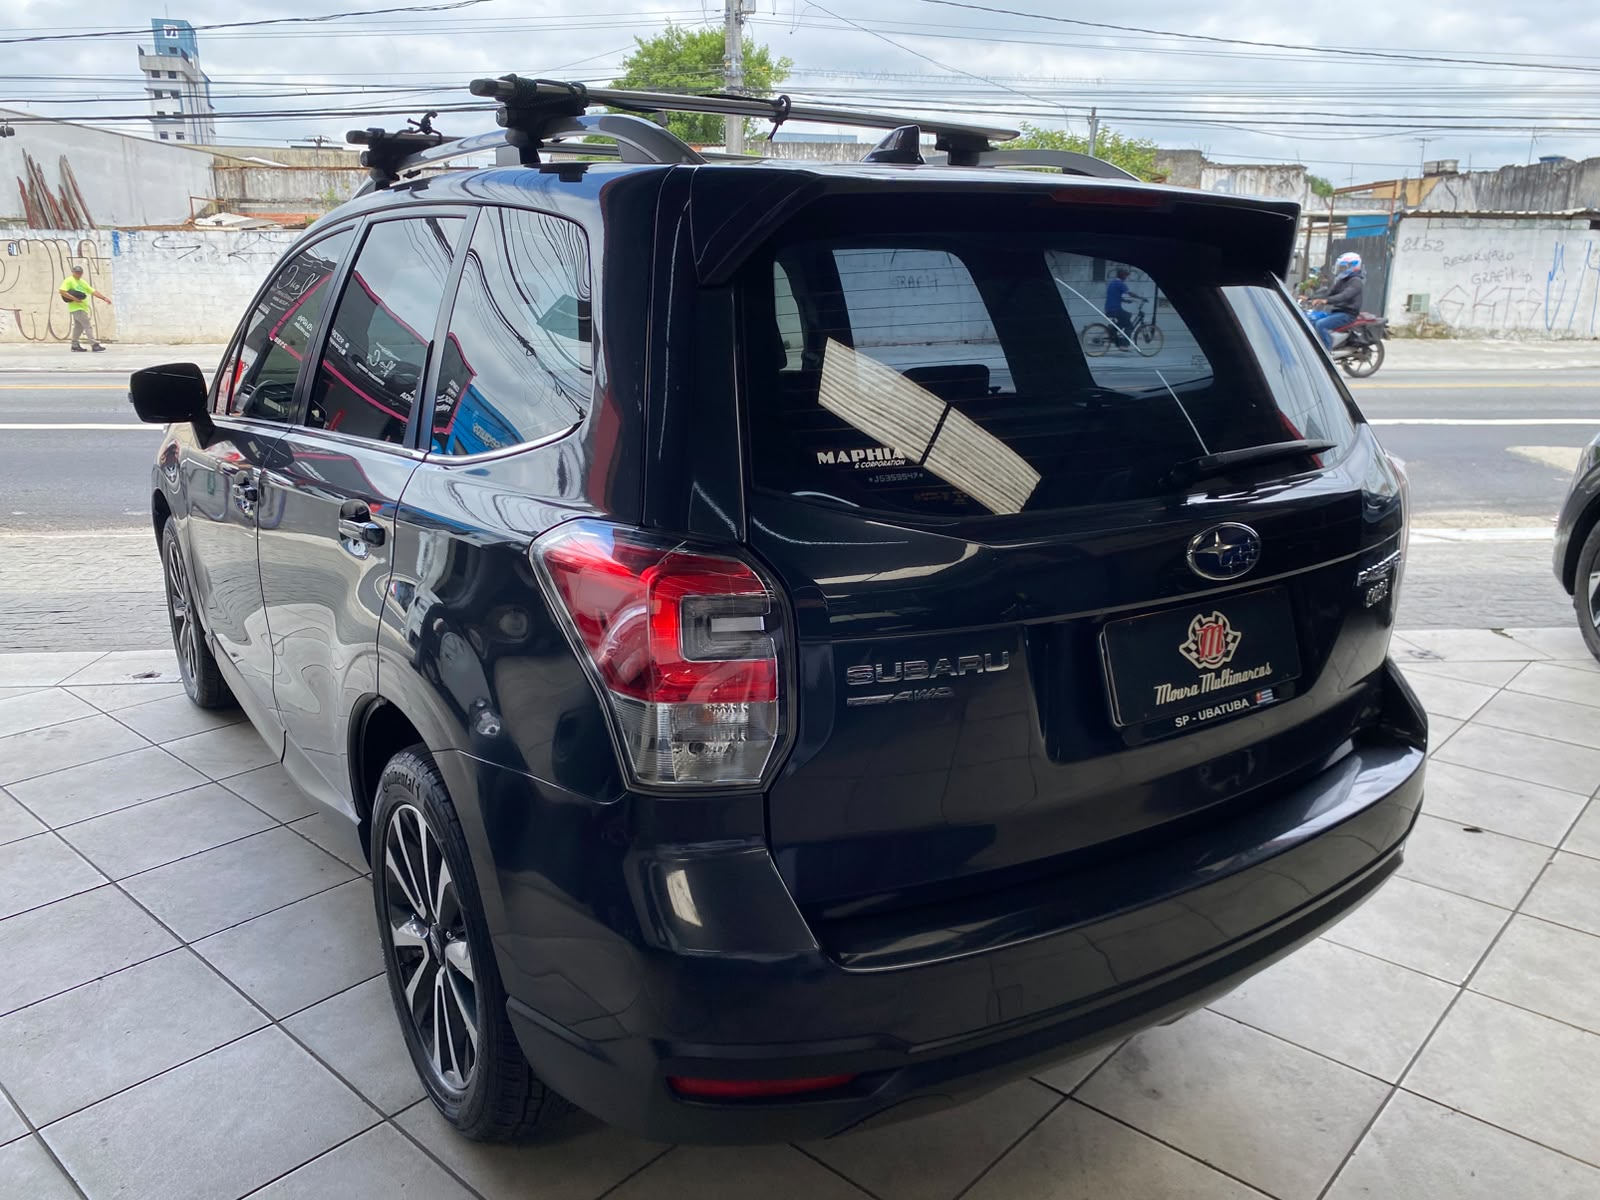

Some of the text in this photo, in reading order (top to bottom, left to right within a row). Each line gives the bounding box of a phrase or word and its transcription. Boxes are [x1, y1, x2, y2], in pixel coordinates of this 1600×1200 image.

[816, 447, 906, 464] MAPHIA
[860, 459, 906, 469] CORPORATION
[846, 650, 1009, 686] SUBARU
[1154, 662, 1272, 705] Moura Multimarcas
[1175, 714, 1190, 728] SP
[1199, 698, 1250, 721] UBATUBA
